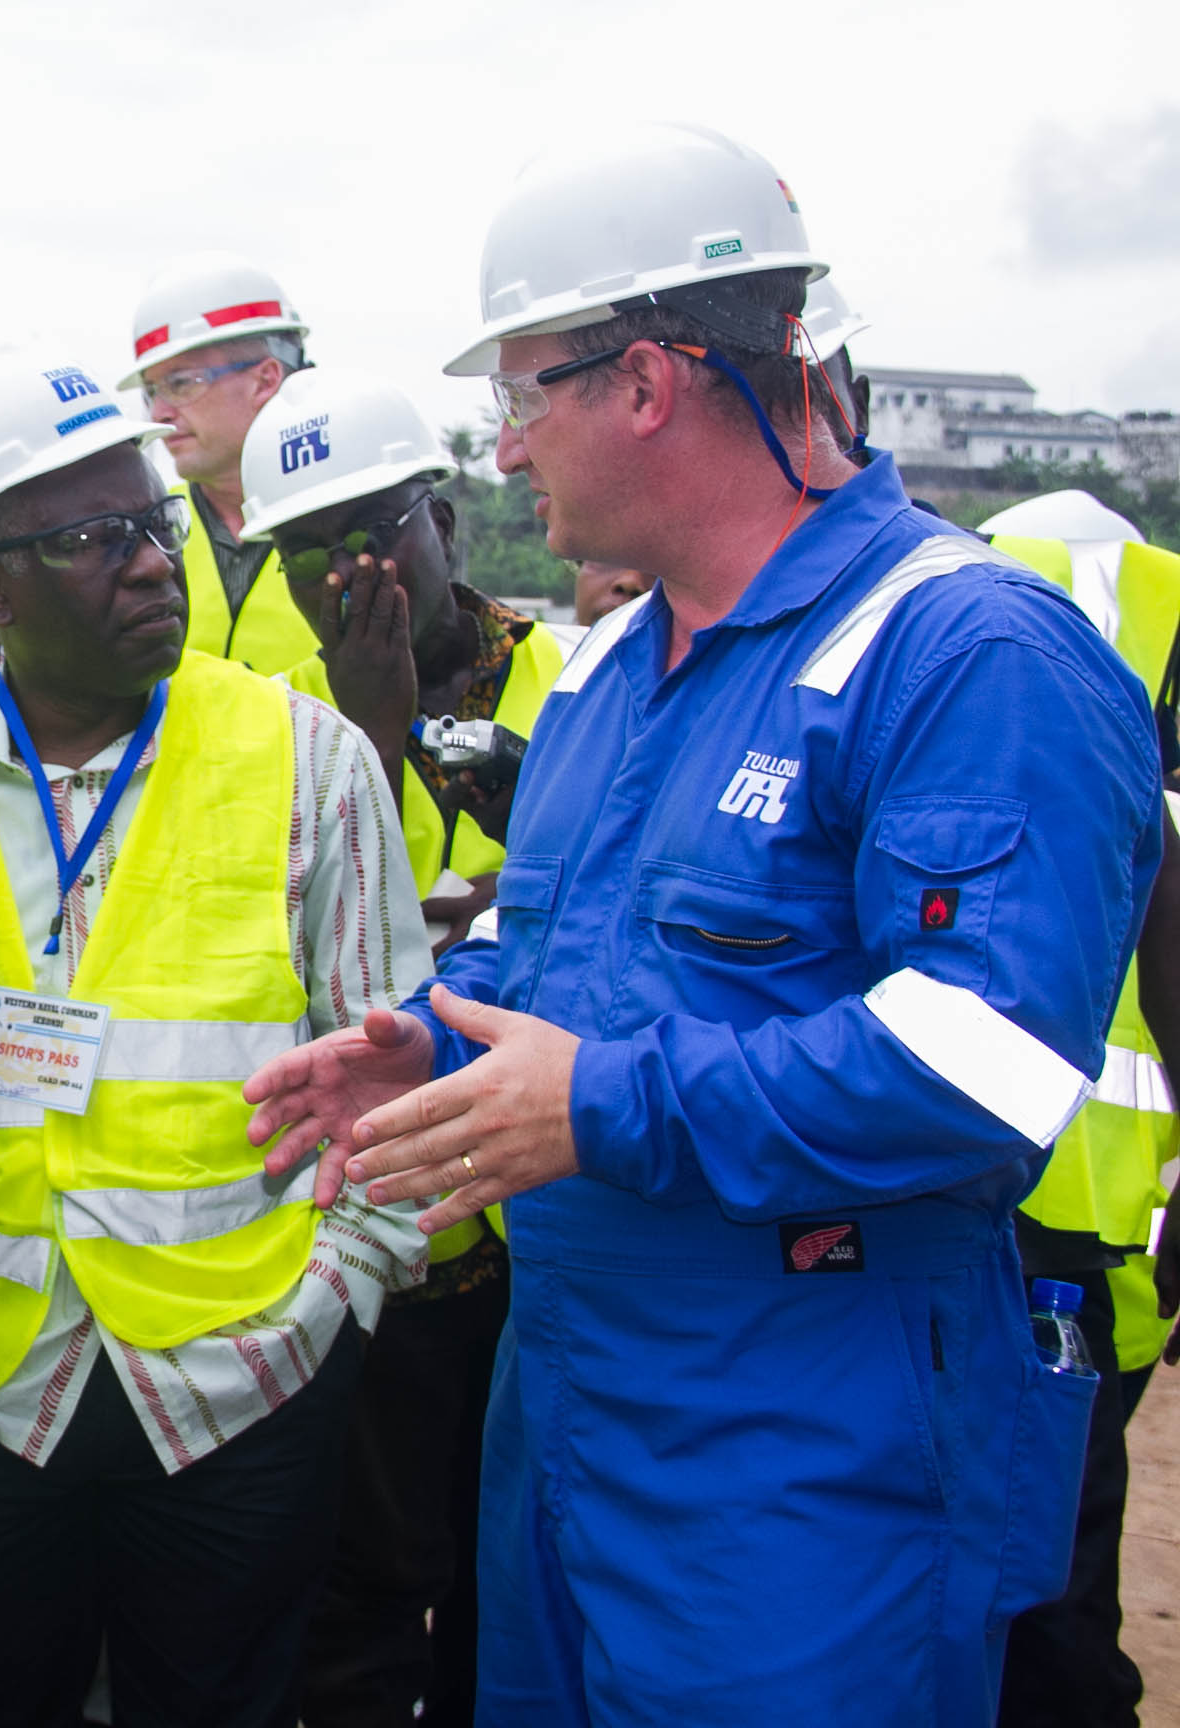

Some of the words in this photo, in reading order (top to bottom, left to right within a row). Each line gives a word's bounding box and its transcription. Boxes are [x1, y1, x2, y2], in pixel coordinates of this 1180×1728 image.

[707, 241, 740, 257] MSA
[59, 410, 101, 434] CHARLES
[279, 414, 329, 441] TULLOW
[742, 750, 800, 778] TULLOW
[4, 997, 36, 1009] WESTERN
[37, 1002, 59, 1014] NAVAL
[61, 1006, 98, 1020] COMMAND
[48, 1051, 80, 1068] PASS
[38, 1075, 58, 1085] CARD
